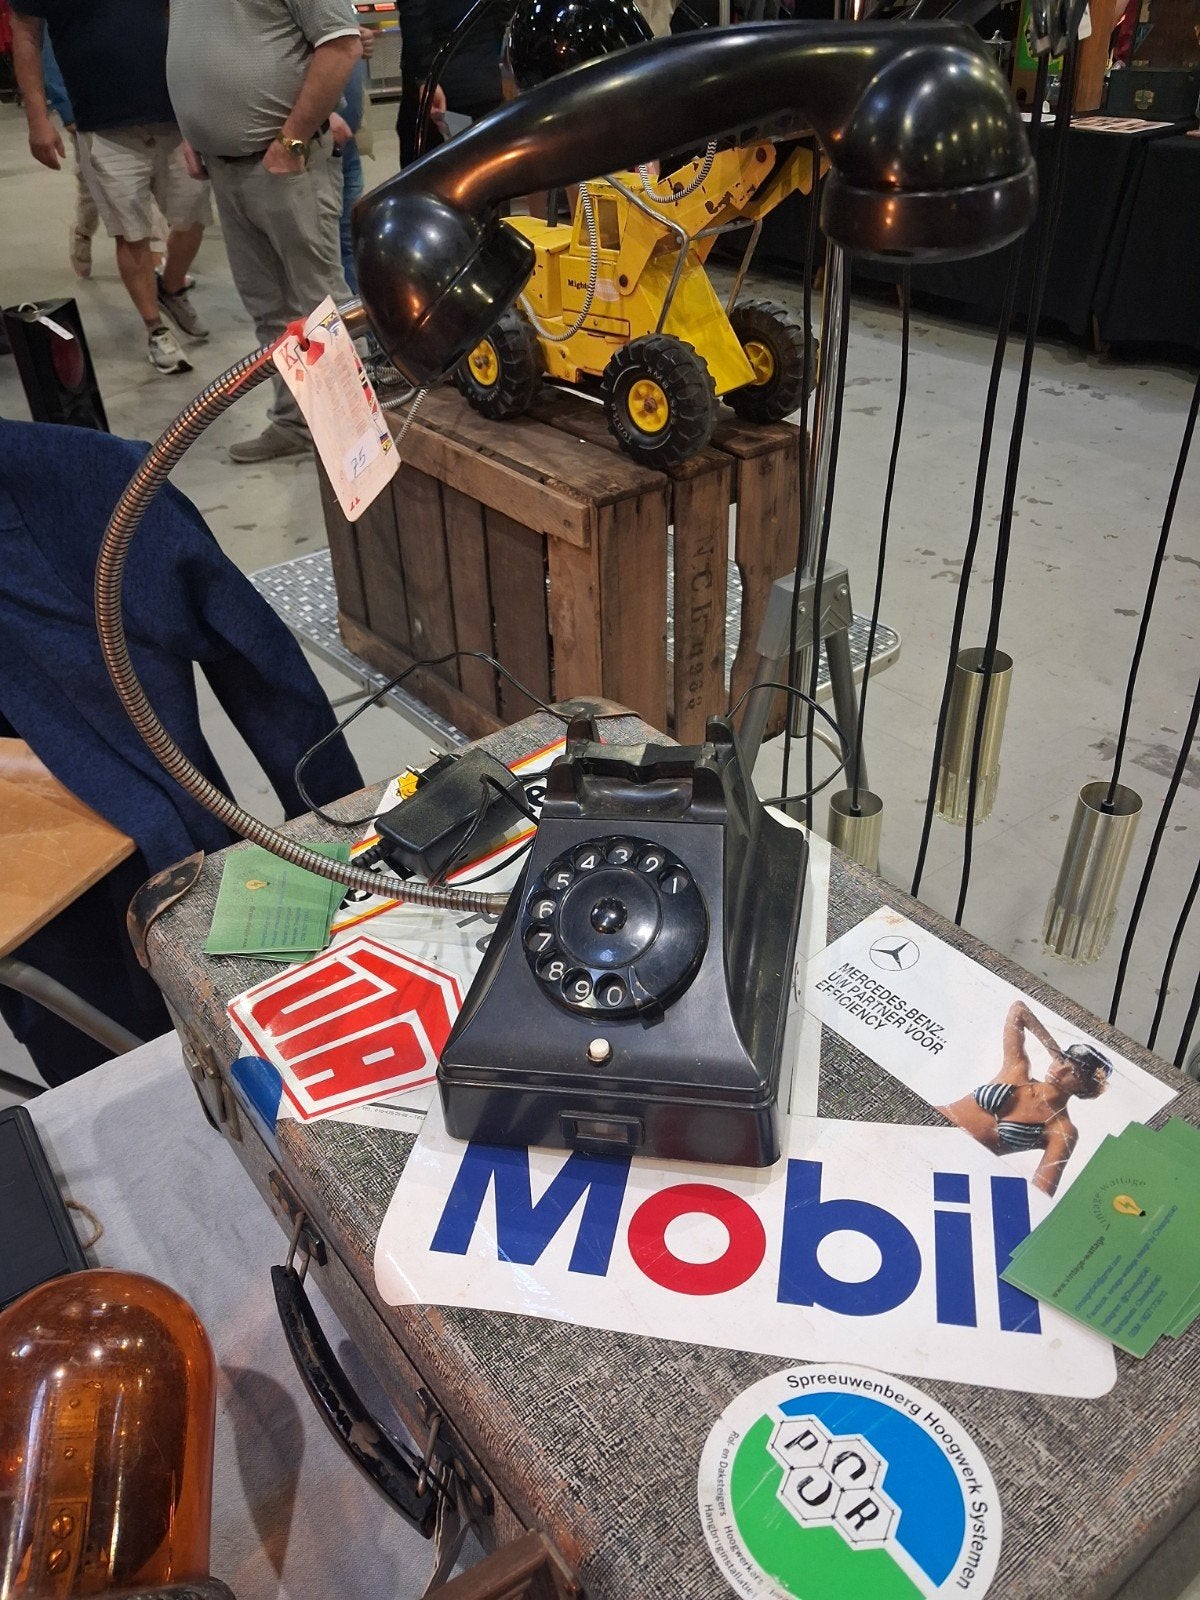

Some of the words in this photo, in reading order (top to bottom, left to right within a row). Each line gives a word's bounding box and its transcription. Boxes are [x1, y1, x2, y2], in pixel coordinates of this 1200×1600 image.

[580, 855, 595, 870] 4
[613, 849, 628, 864] 3
[556, 873, 570, 890] 5
[672, 877, 678, 894] 1
[539, 901, 553, 919] 6
[537, 933, 552, 951] 7
[548, 961, 564, 981] 8
[574, 980, 590, 1000] 9
[606, 986, 623, 1006] 0
[815, 980, 887, 1030] EFFICIENCY
[828, 971, 852, 989] UW
[847, 985, 906, 1028] PARTNER
[904, 1024, 943, 1055] VOOR
[430, 1143, 1042, 1335] Mobil
[721, 1448, 730, 1459] en
[715, 1461, 729, 1517] Daksteigers
[787, 1374, 922, 1416] Spreeuwenberg
[923, 1411, 982, 1495] Hoogwerk
[956, 1501, 988, 1590] Systemen
